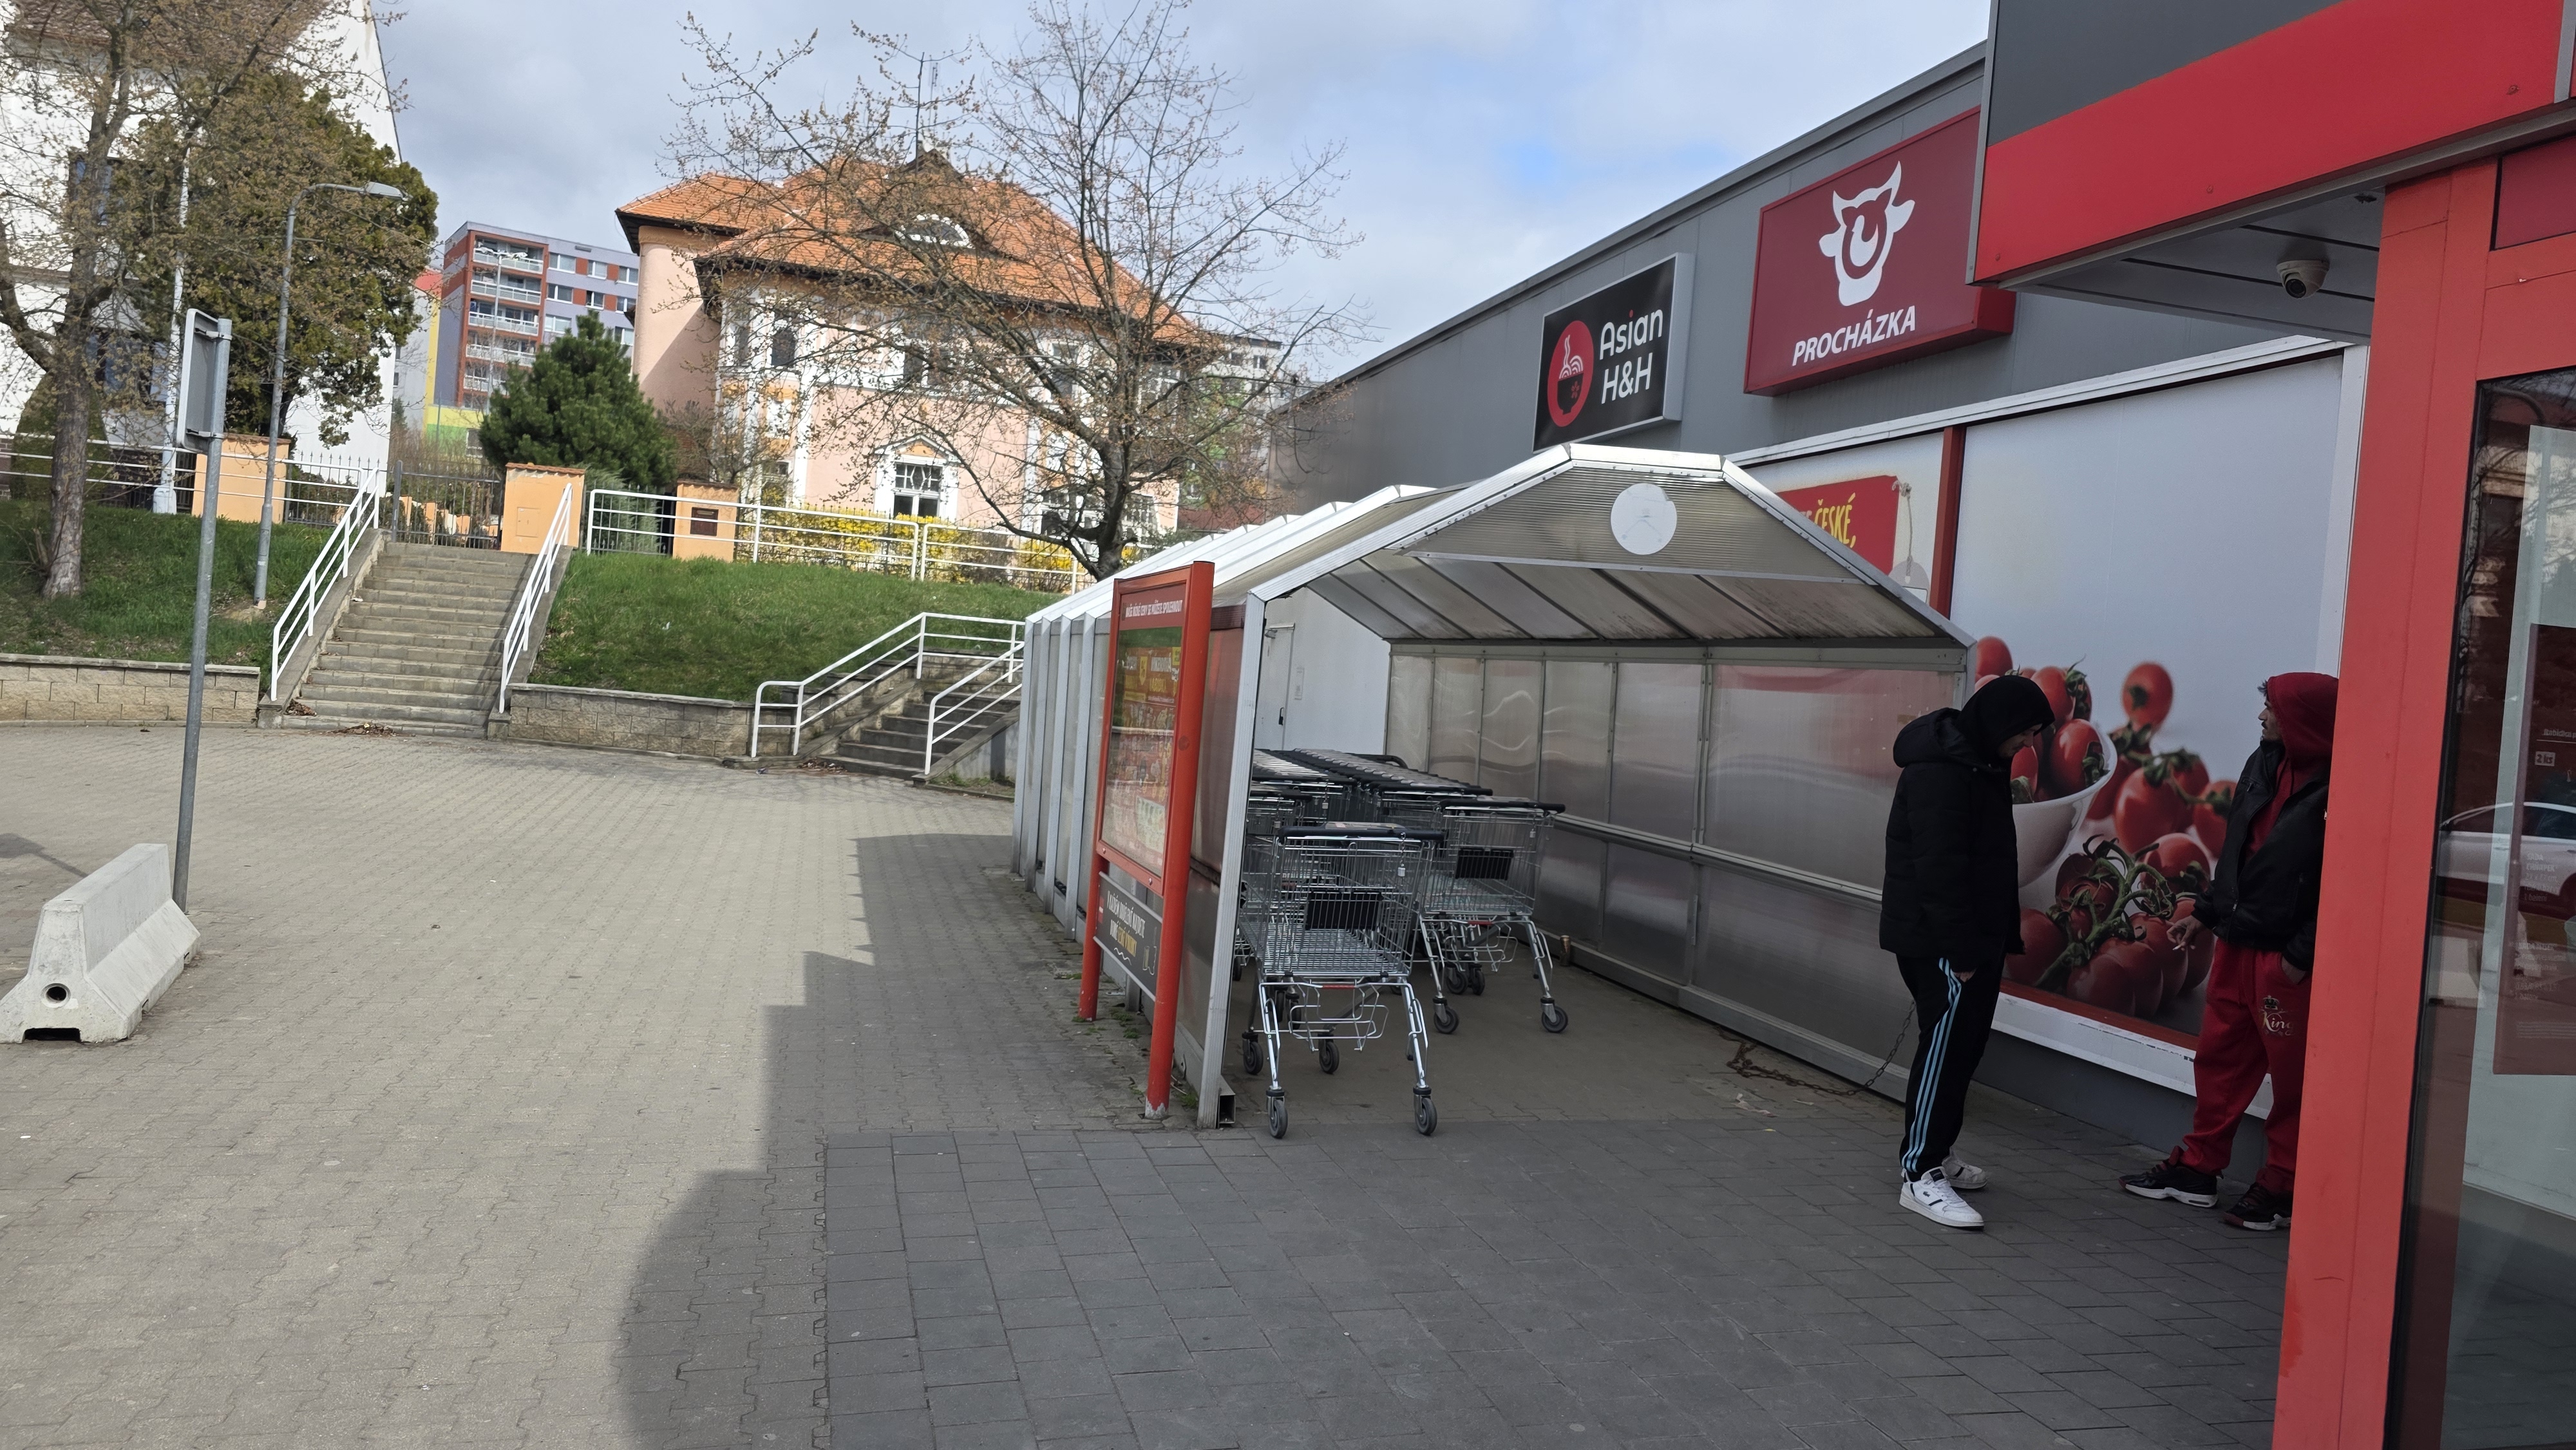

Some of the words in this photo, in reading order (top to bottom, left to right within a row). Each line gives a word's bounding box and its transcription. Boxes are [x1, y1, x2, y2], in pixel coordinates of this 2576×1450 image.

[1600, 310, 1663, 360] Asian
[1792, 305, 1915, 366] PROCHÁZKA
[1602, 353, 1653, 404] H&H
[2537, 754, 2542, 763] 2
